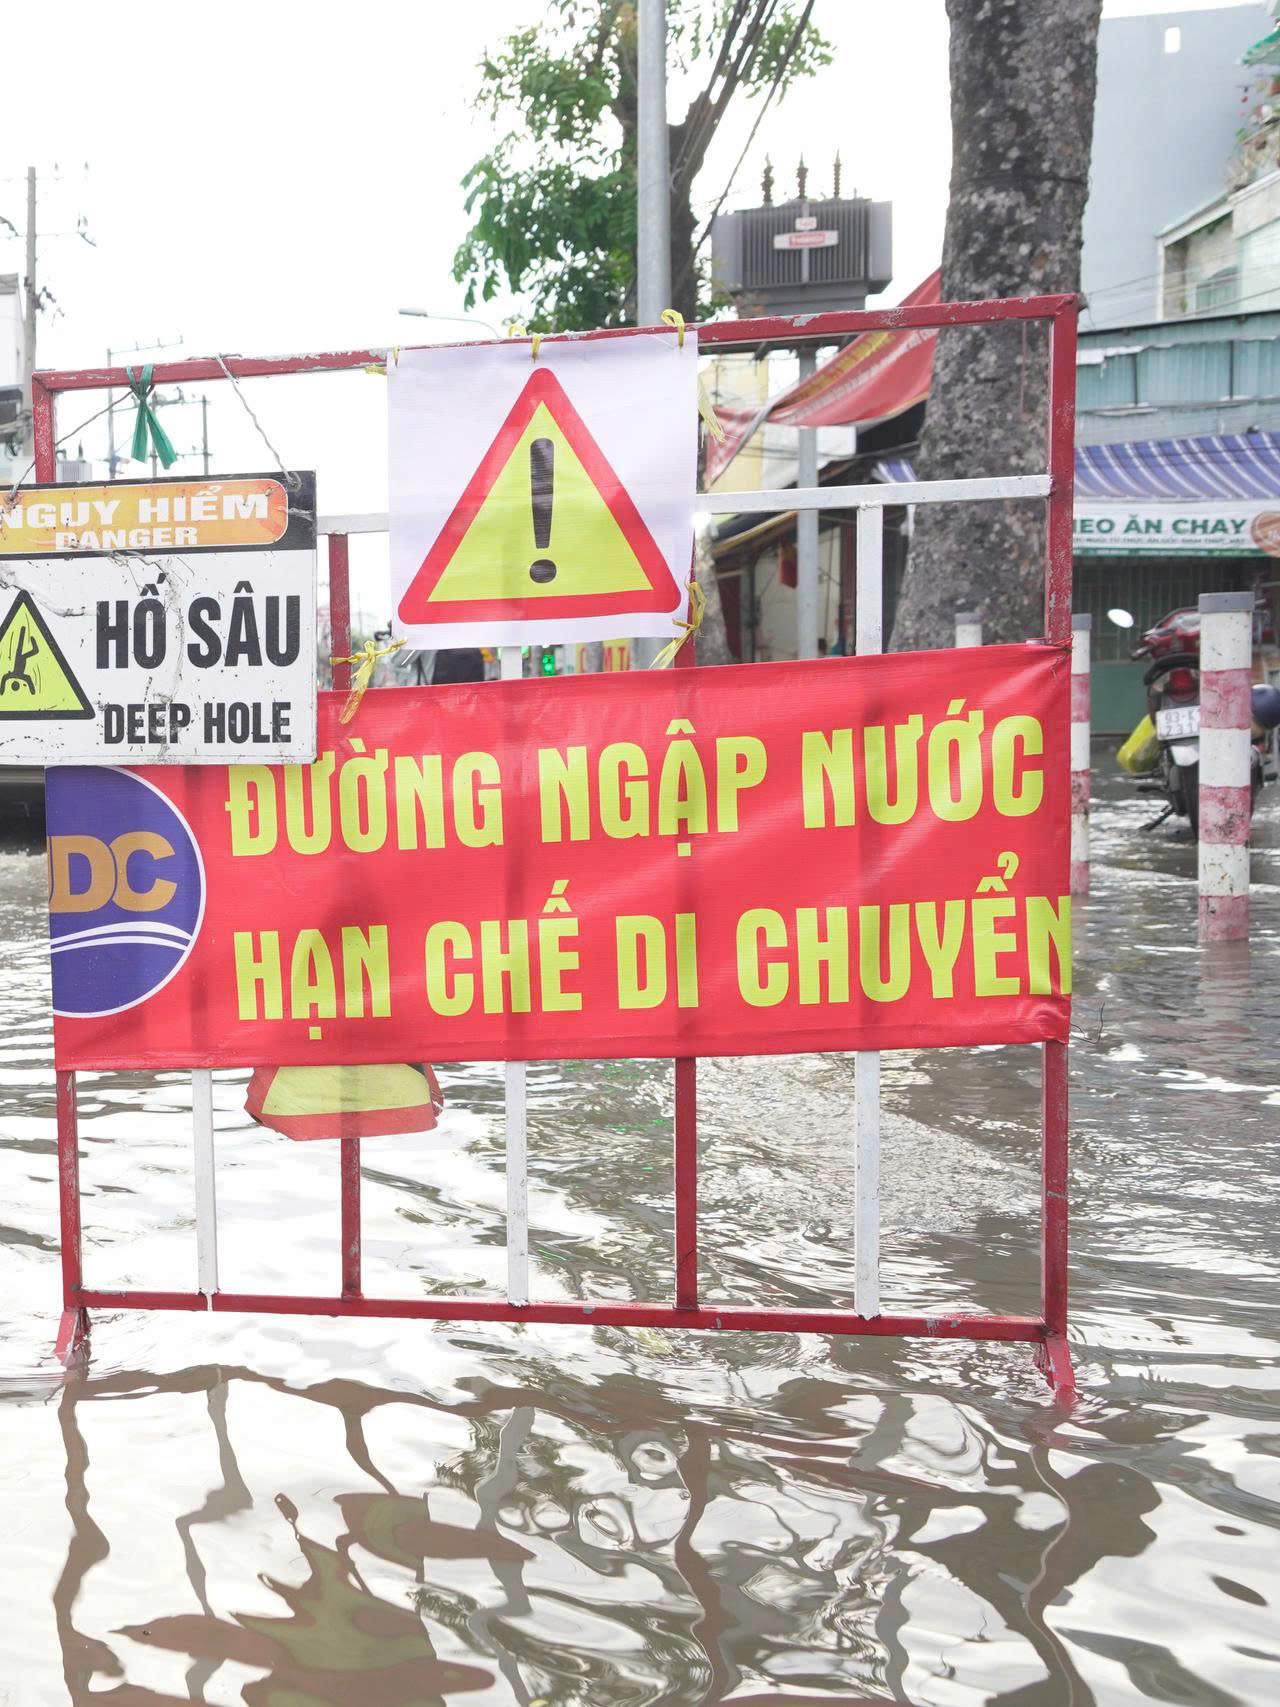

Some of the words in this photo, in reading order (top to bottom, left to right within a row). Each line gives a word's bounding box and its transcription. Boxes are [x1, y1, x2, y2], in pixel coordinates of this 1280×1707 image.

[139, 485, 269, 524] HIẾM
[1123, 513, 1163, 534] ĂN
[1171, 518, 1247, 535] CHAY
[55, 526, 198, 550] DANGER
[96, 573, 168, 669] HỐ
[187, 581, 301, 669] SÂU
[104, 703, 191, 744] DEEP
[204, 702, 292, 744] HOLE
[225, 737, 504, 857] ĐƯỜNG
[537, 719, 767, 857] NGẬP
[802, 699, 1044, 831] NƯỚC
[234, 924, 392, 1040] HẠN
[425, 879, 582, 1017] CHẾ
[616, 912, 699, 1009] DI
[736, 851, 1072, 1009] CHUYỂN
